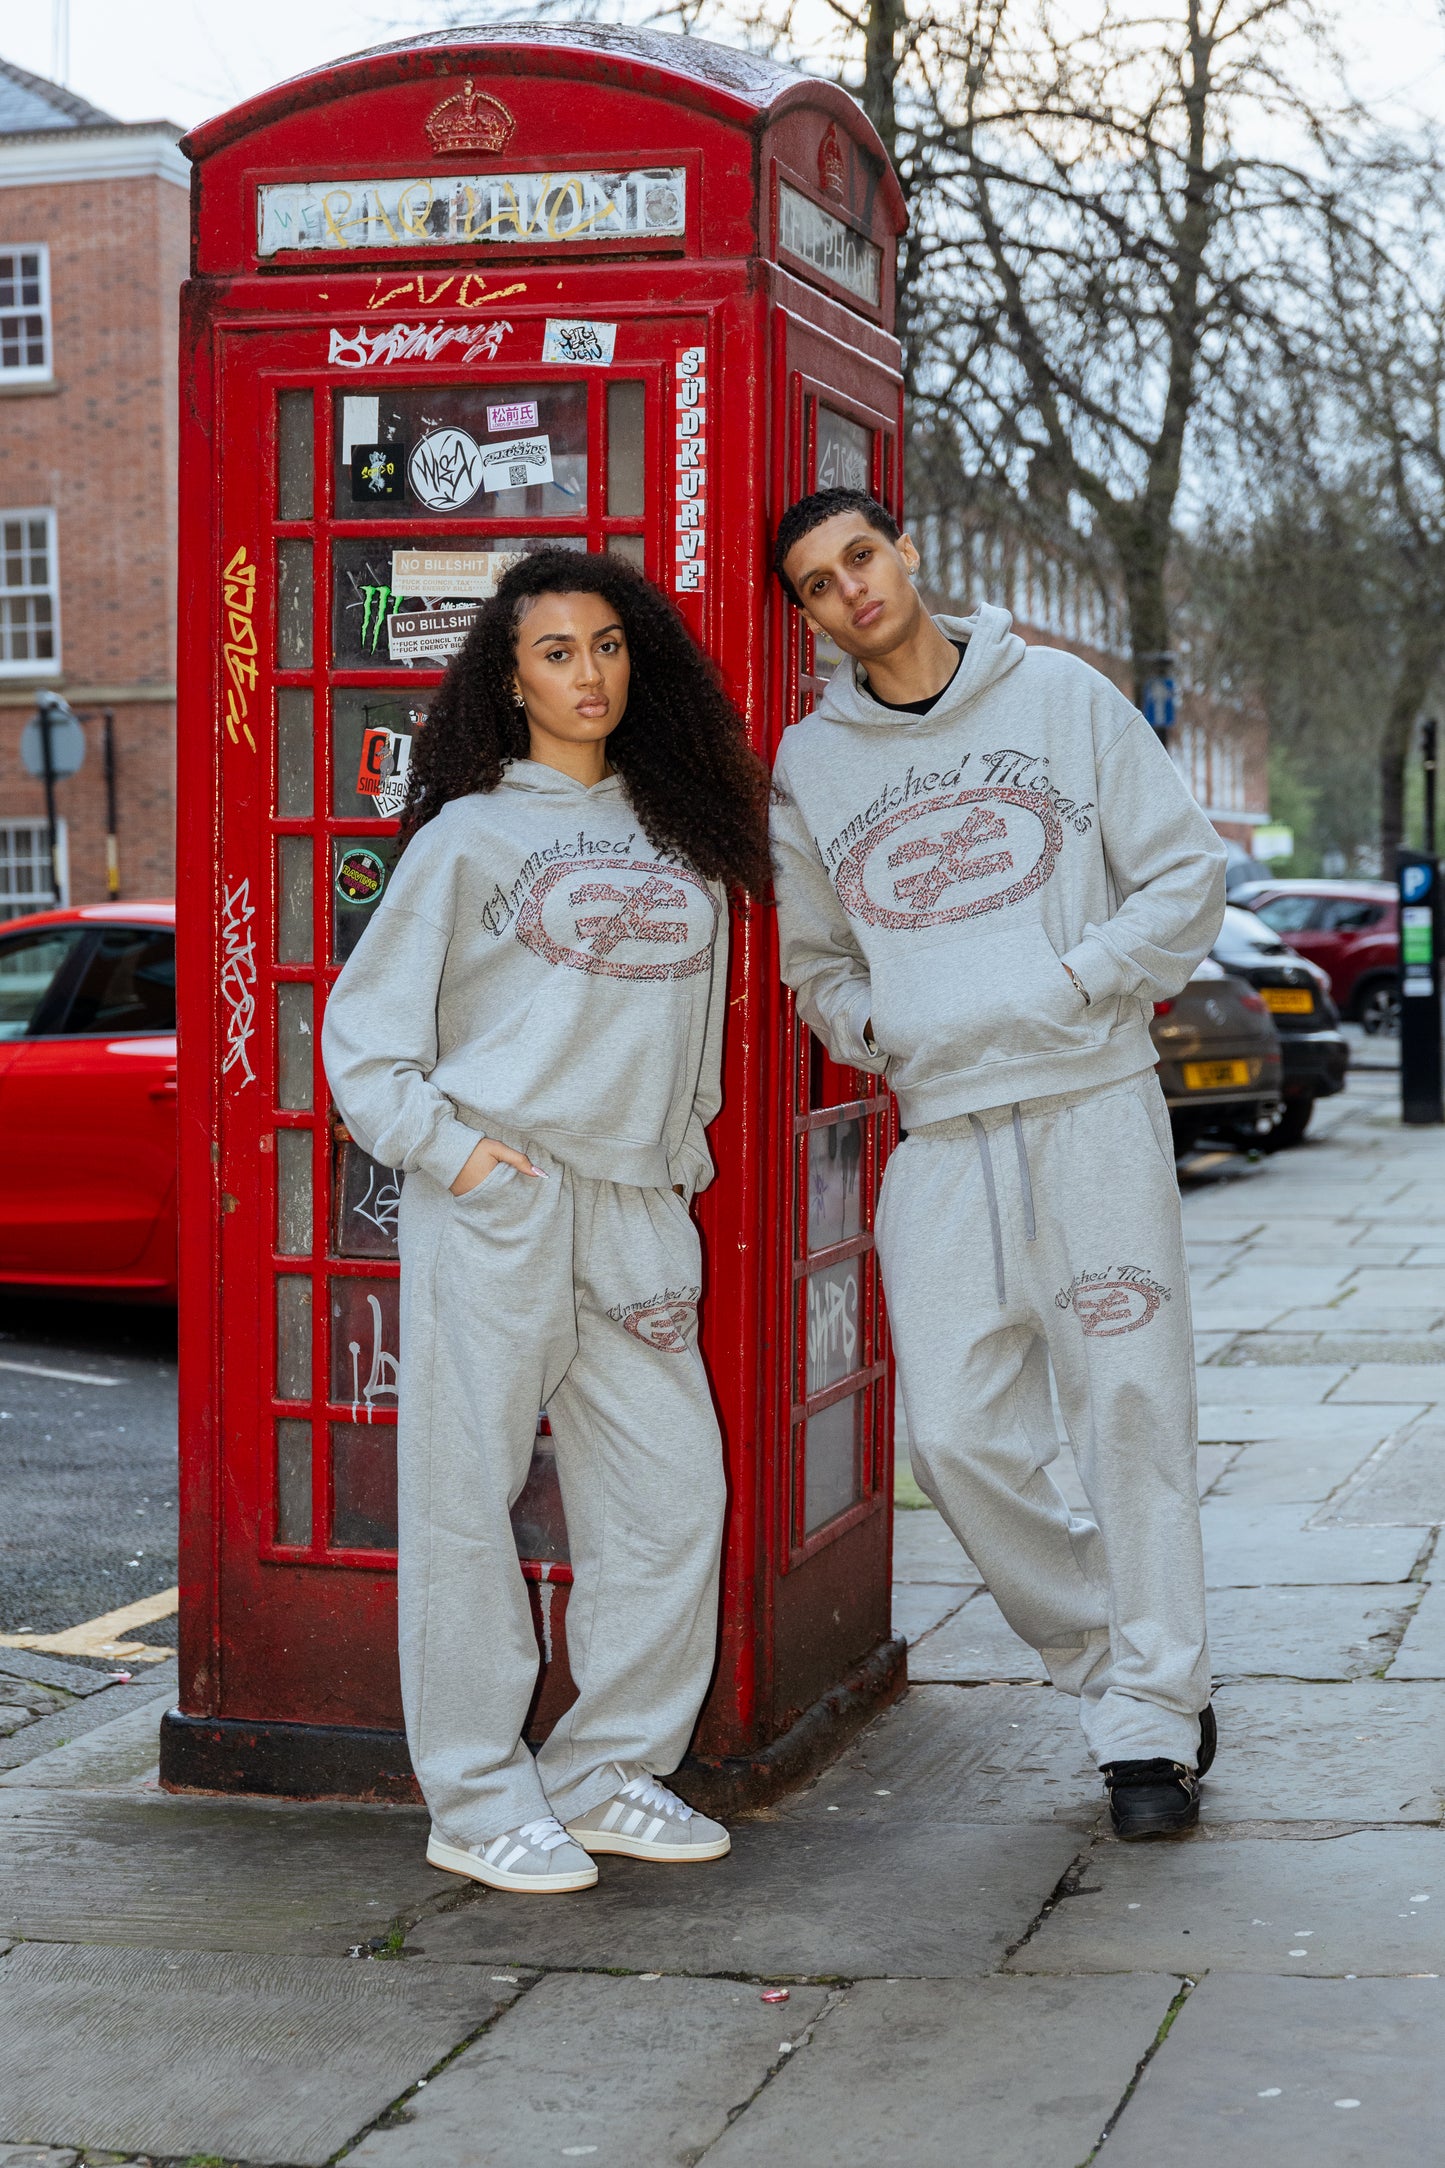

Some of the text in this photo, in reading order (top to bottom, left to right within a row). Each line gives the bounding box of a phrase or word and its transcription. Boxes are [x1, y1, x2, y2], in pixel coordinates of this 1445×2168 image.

[492, 405, 534, 423] 松前氏
[681, 350, 699, 589] SÜDKURVE
[401, 560, 484, 571] NO BILLSHIT
[396, 615, 477, 632] NO BILLSHIT
[814, 753, 971, 876] nmatched
[481, 831, 636, 939] Unmatched
[1404, 866, 1426, 897] P
[1116, 1265, 1173, 1302] Morals
[606, 1285, 688, 1322] Unmatched
